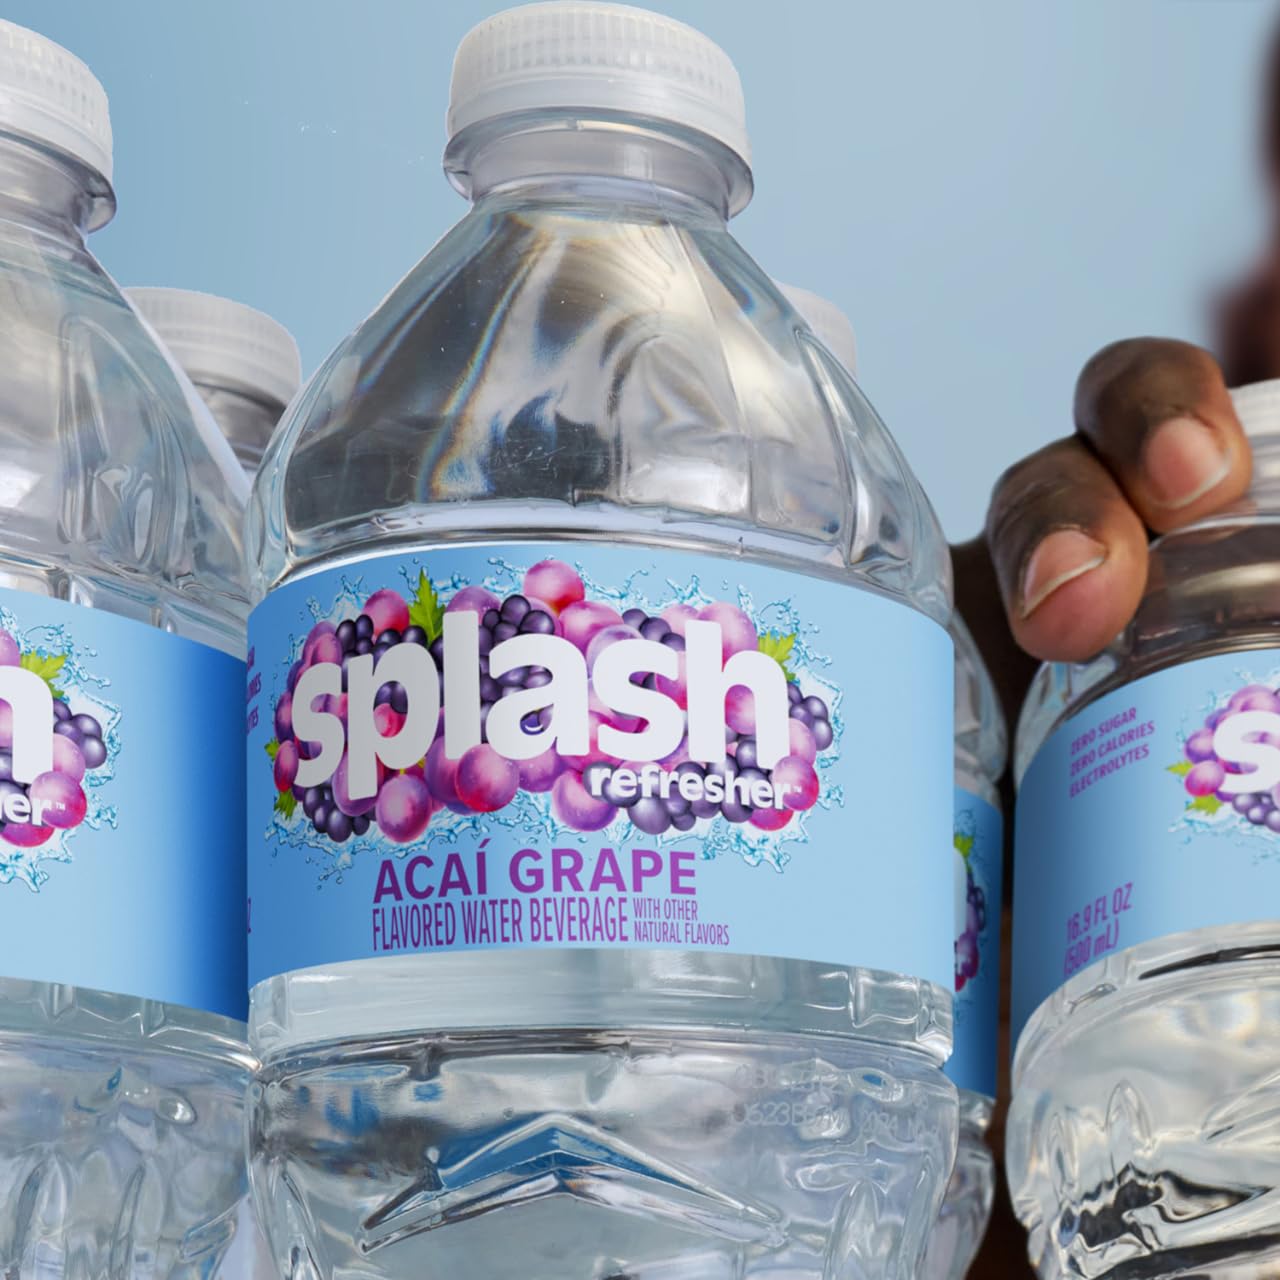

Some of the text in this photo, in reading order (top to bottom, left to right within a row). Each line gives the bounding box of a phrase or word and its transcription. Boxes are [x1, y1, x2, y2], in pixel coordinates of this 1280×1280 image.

[291, 610, 790, 800] splash
[1071, 706, 1137, 756] ZERO SUGAR
[1070, 743, 1149, 798] ELECTROLYTES
[1071, 719, 1155, 776] ZERO CALORIES
[373, 838, 697, 904] ACAÍ GRAPE
[372, 896, 629, 951] FLAVORED WATER BEVERAGE
[633, 898, 698, 921] WITH OTHER
[1094, 895, 1108, 927] FL
[1113, 882, 1133, 914] OZ
[634, 921, 730, 947] NATURAL FLAVORS
